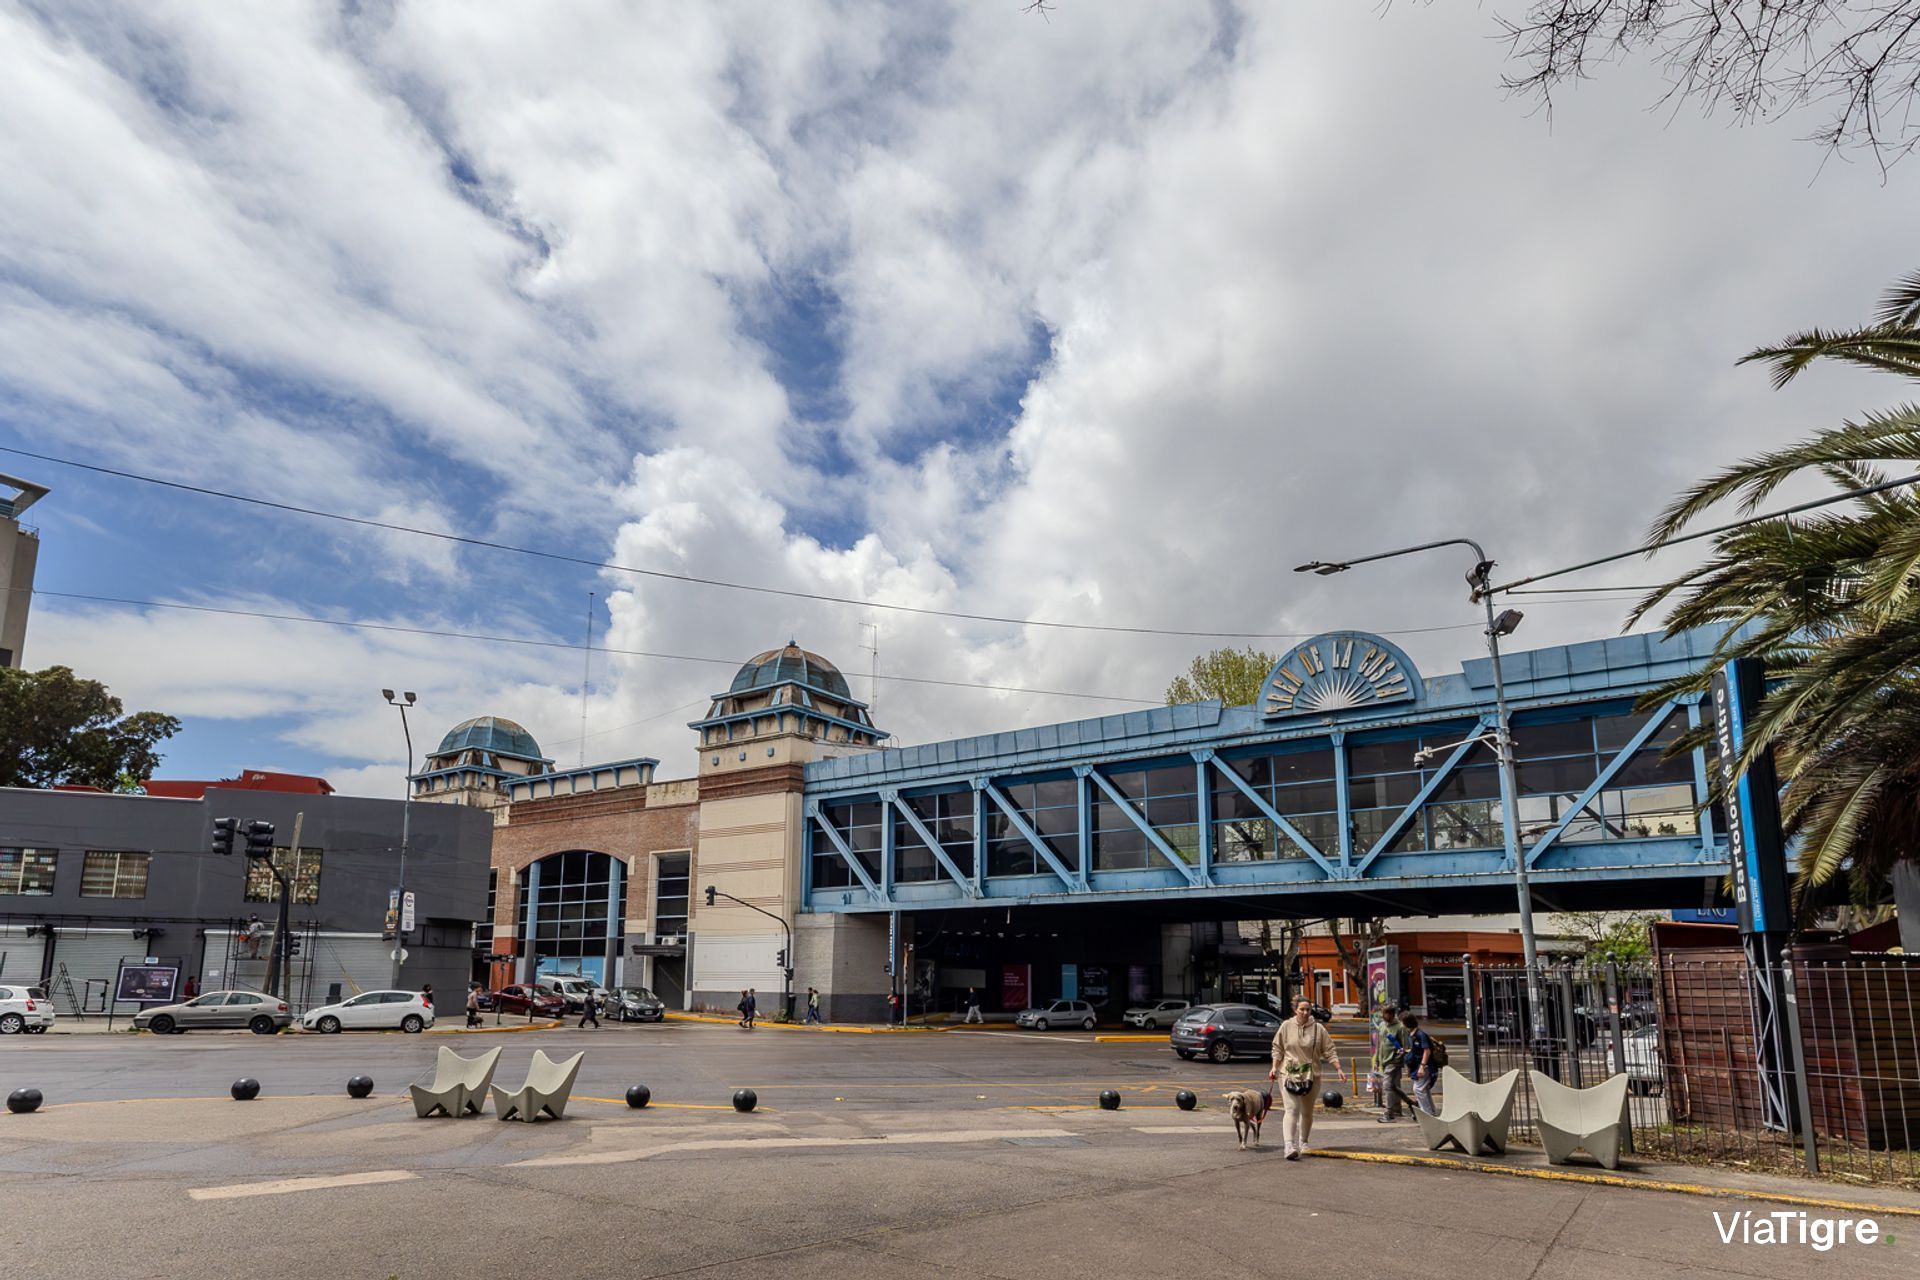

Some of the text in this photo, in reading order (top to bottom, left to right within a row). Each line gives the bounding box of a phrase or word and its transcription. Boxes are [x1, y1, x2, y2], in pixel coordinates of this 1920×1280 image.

[1264, 639, 1408, 714] TREN DE LA COSTA
[1717, 688, 1731, 758] Mitre
